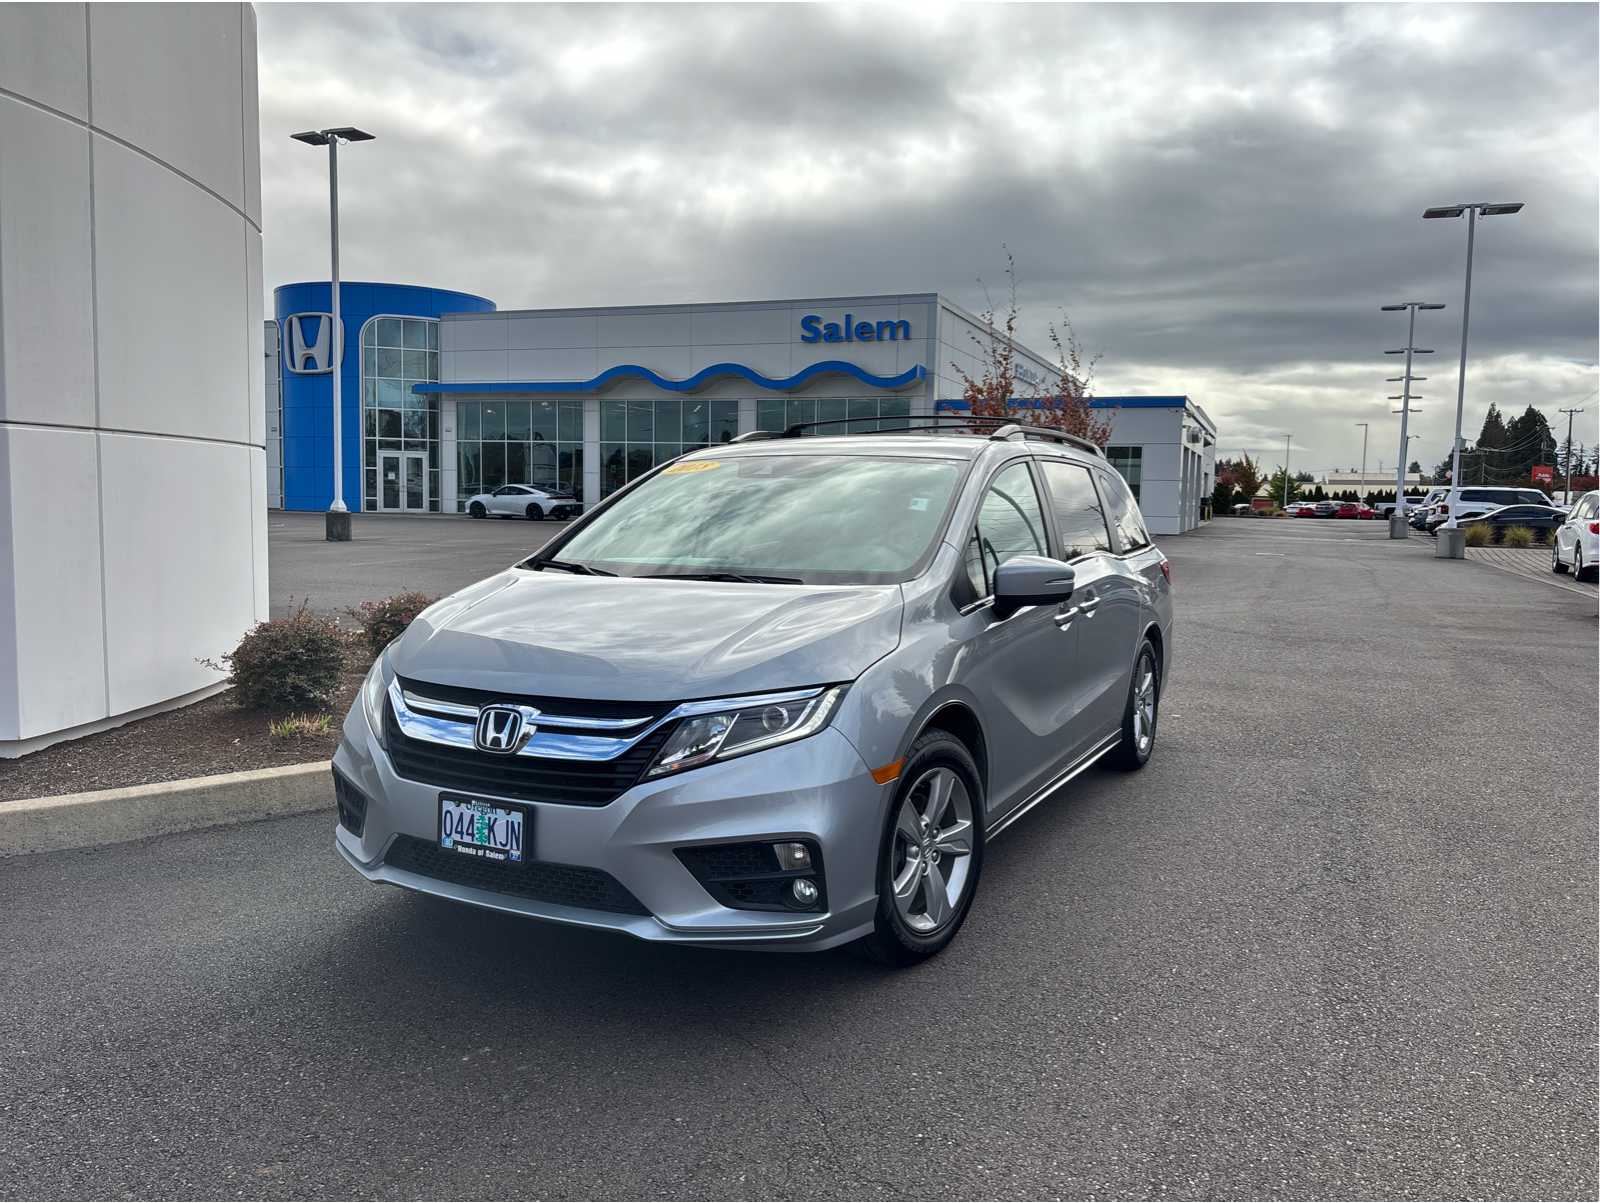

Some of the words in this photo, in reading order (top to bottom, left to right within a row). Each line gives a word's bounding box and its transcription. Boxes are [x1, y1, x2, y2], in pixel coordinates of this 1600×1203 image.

[800, 313, 911, 343] Salem
[443, 809, 476, 842] 044
[487, 815, 521, 851] KJN
[457, 845, 477, 855] Honda
[485, 850, 505, 860] Salem
